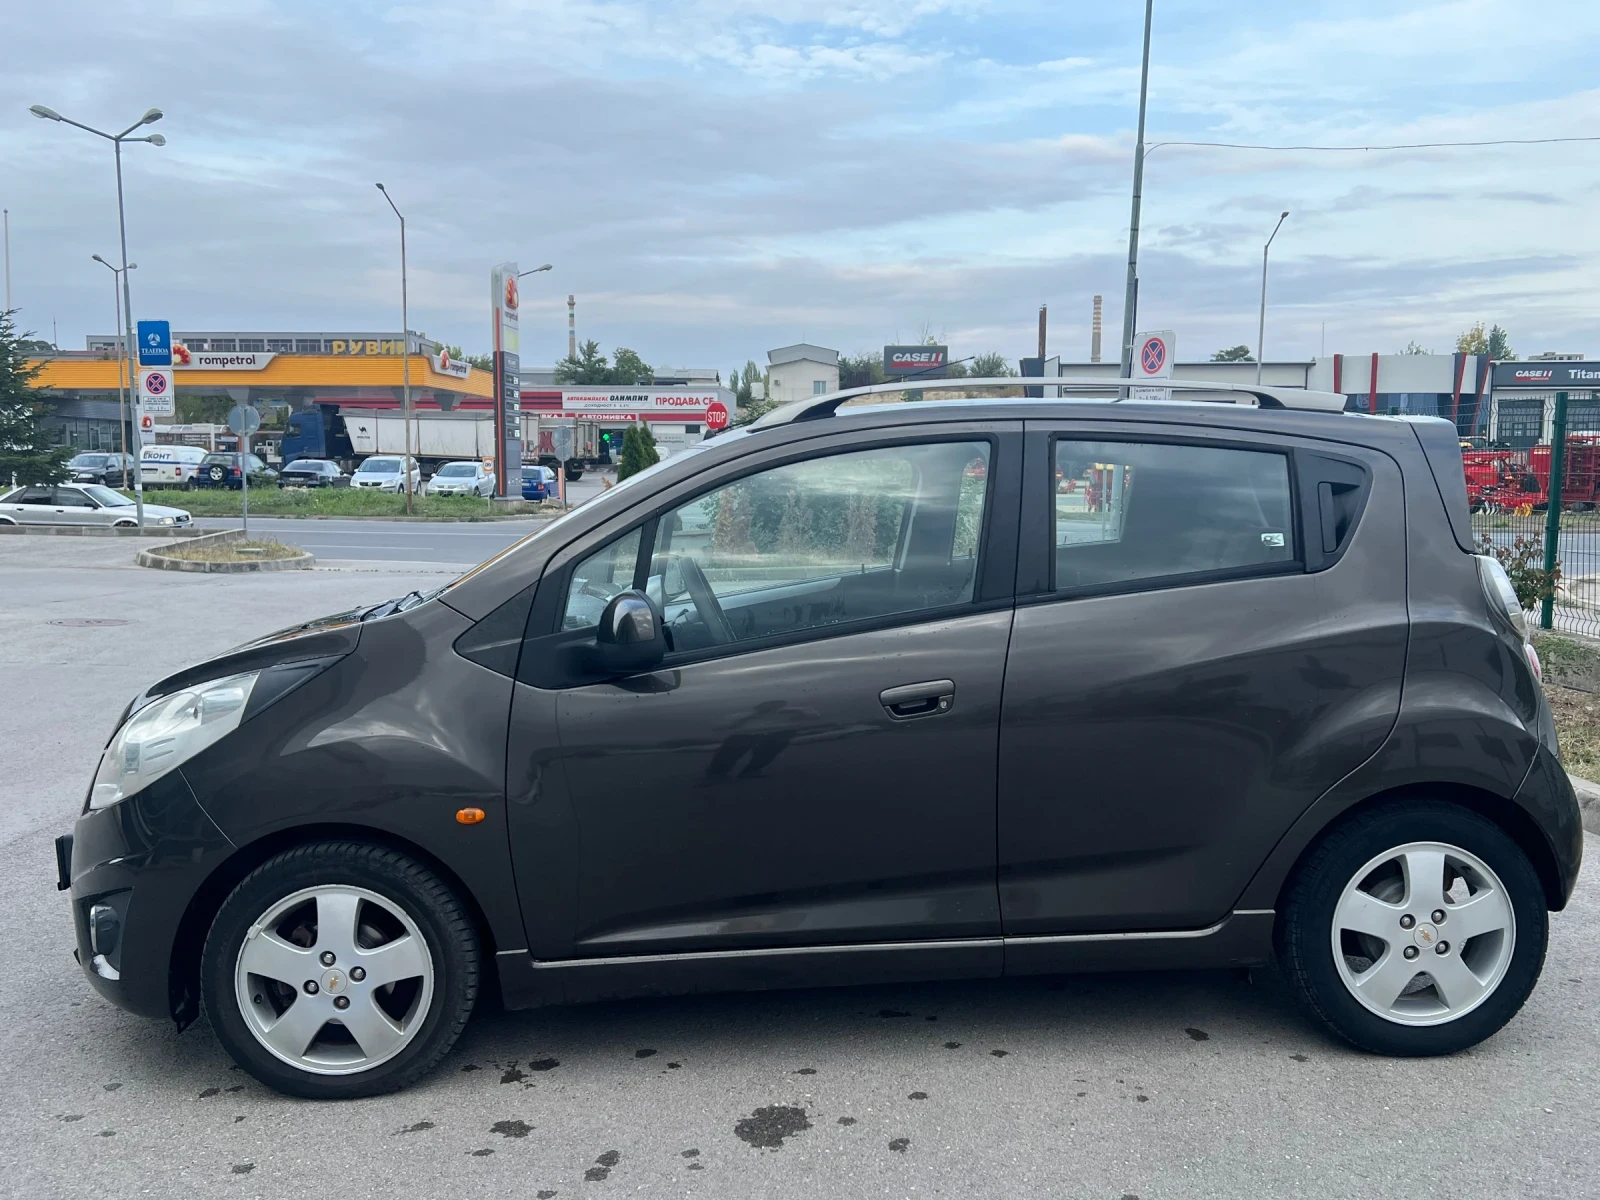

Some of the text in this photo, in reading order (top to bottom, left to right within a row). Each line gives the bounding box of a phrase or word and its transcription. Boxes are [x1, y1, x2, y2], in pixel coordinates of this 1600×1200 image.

[199, 354, 256, 368] rompetrol
[892, 352, 930, 362] CASE
[655, 397, 701, 407] ПРОДАВА
[707, 411, 726, 423] STOP
